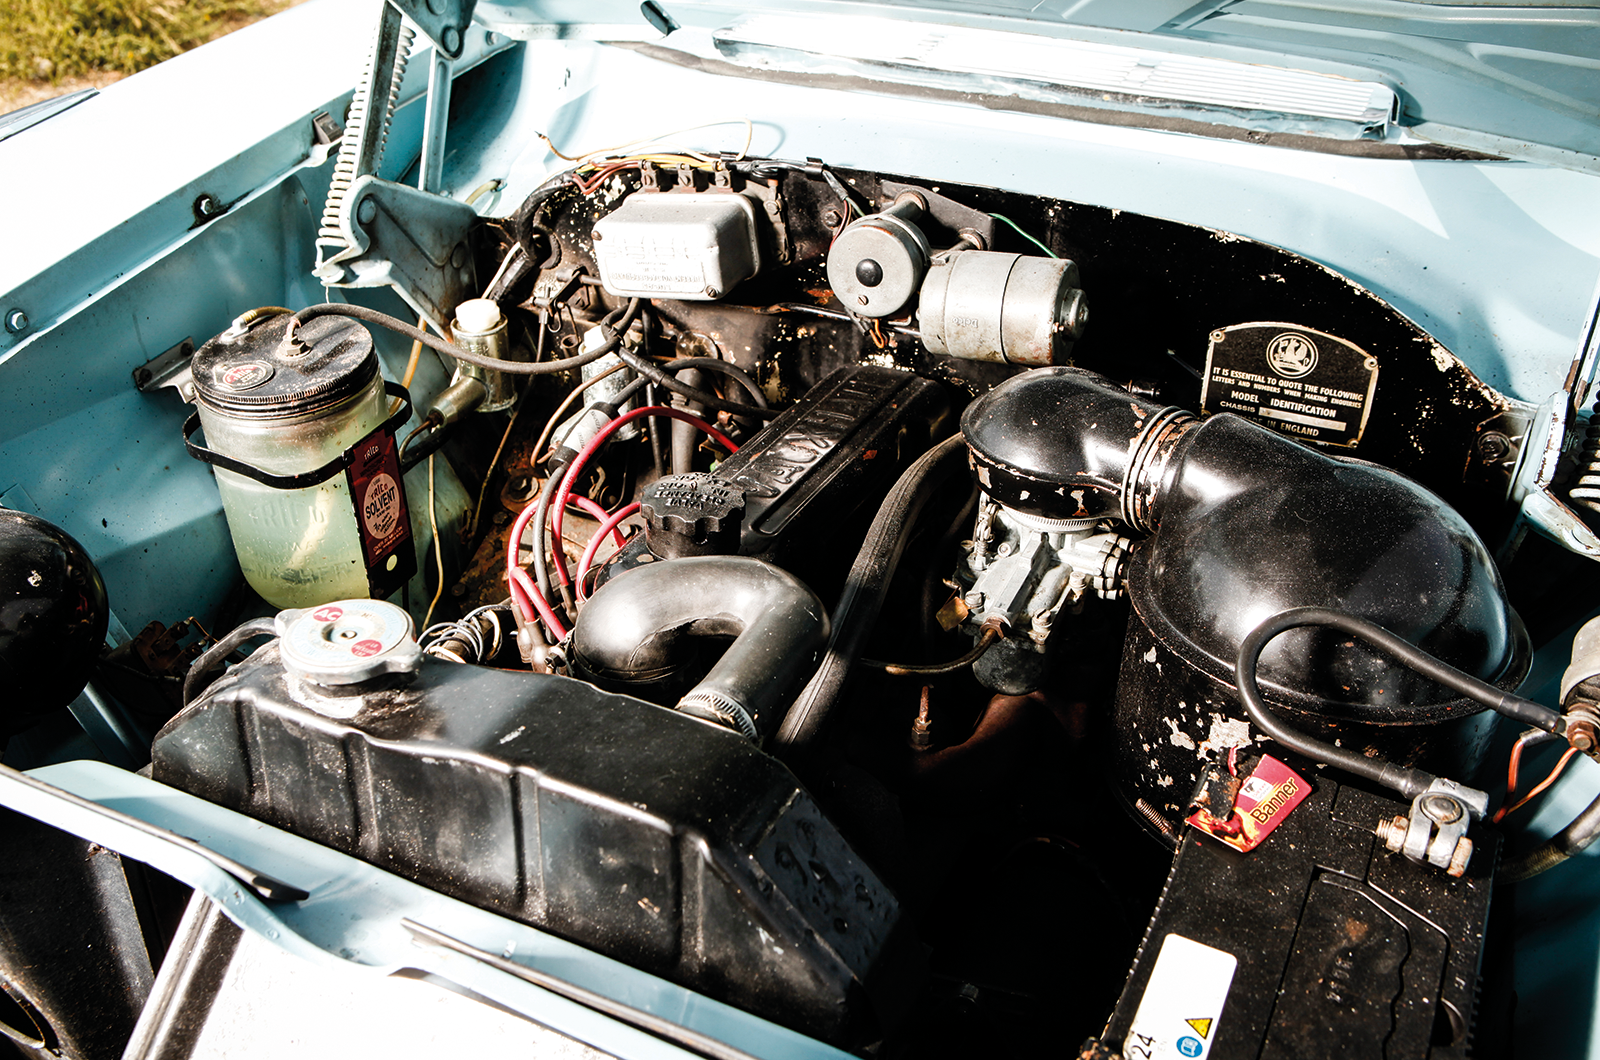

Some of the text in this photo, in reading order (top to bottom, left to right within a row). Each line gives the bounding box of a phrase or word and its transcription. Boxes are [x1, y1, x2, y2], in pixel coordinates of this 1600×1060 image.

[951, 316, 979, 329] Delco
[1212, 375, 1235, 385] LETTERS
[1238, 380, 1251, 388] AND
[1253, 382, 1281, 394] NUMBERS
[1284, 388, 1301, 398] WHEN
[1304, 392, 1328, 403] MAKING
[1213, 367, 1364, 401] IT IS ESSENTIAL TO QUOTE THE FOLLOWING
[1219, 400, 1256, 413] CHASSIS
[1231, 390, 1337, 418] MODEL IDENTIFICATION
[1267, 420, 1276, 429] IN
[1280, 422, 1320, 437] ENGLAND
[364, 485, 396, 520] SOLVENT
[370, 483, 389, 500] TRICO
[314, 608, 342, 621] AC
[1249, 777, 1299, 825] Banner
